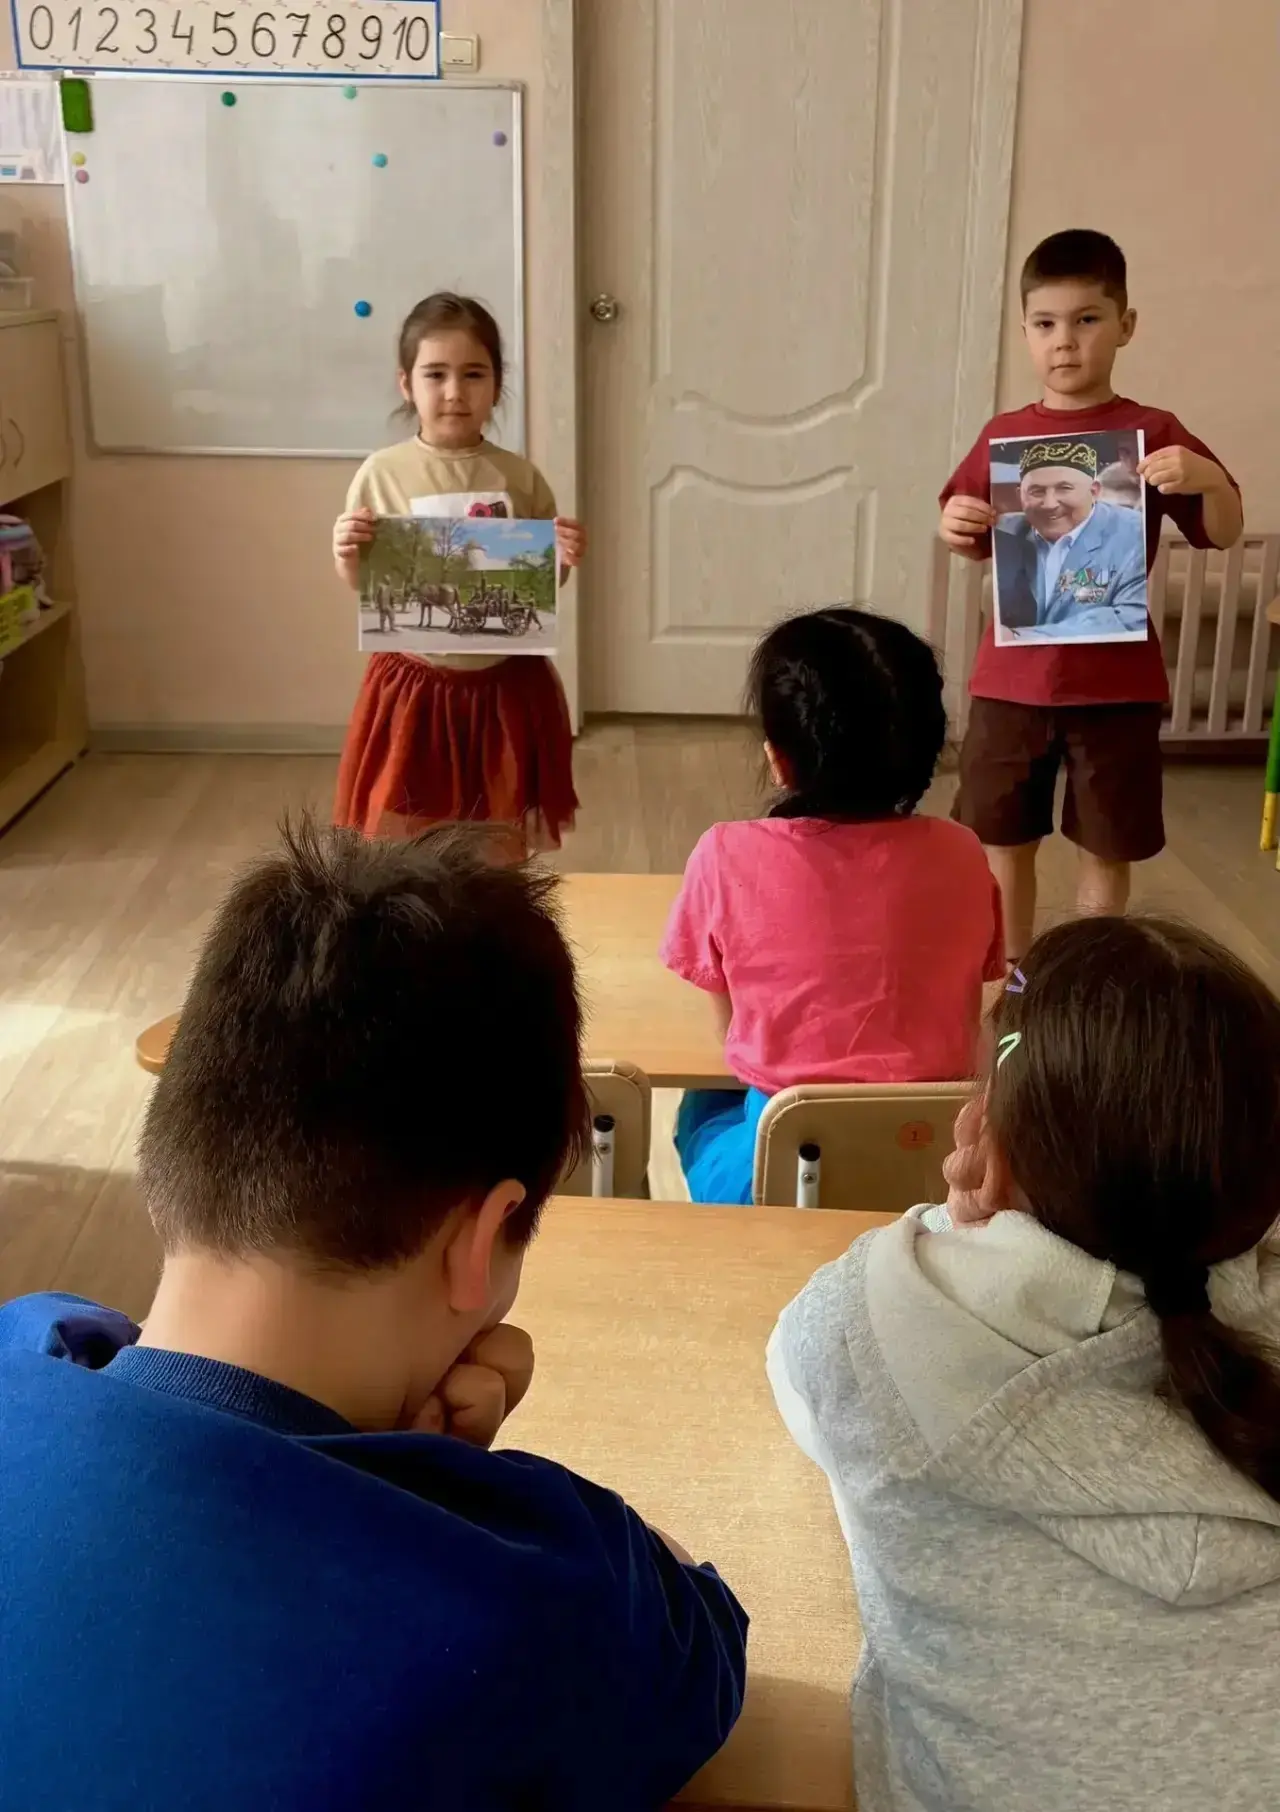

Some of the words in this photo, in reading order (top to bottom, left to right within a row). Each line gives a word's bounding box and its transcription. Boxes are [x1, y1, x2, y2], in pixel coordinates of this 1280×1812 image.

[30, 5, 53, 50] 0
[69, 8, 82, 51] 1
[96, 7, 119, 53] 2
[136, 8, 157, 54] 3
[172, 10, 194, 55] 4
[212, 11, 237, 56] 5
[251, 12, 276, 57] 6
[286, 13, 310, 58] 7
[322, 14, 346, 59] 8
[359, 15, 382, 60] 9
[393, 16, 429, 61] 10
